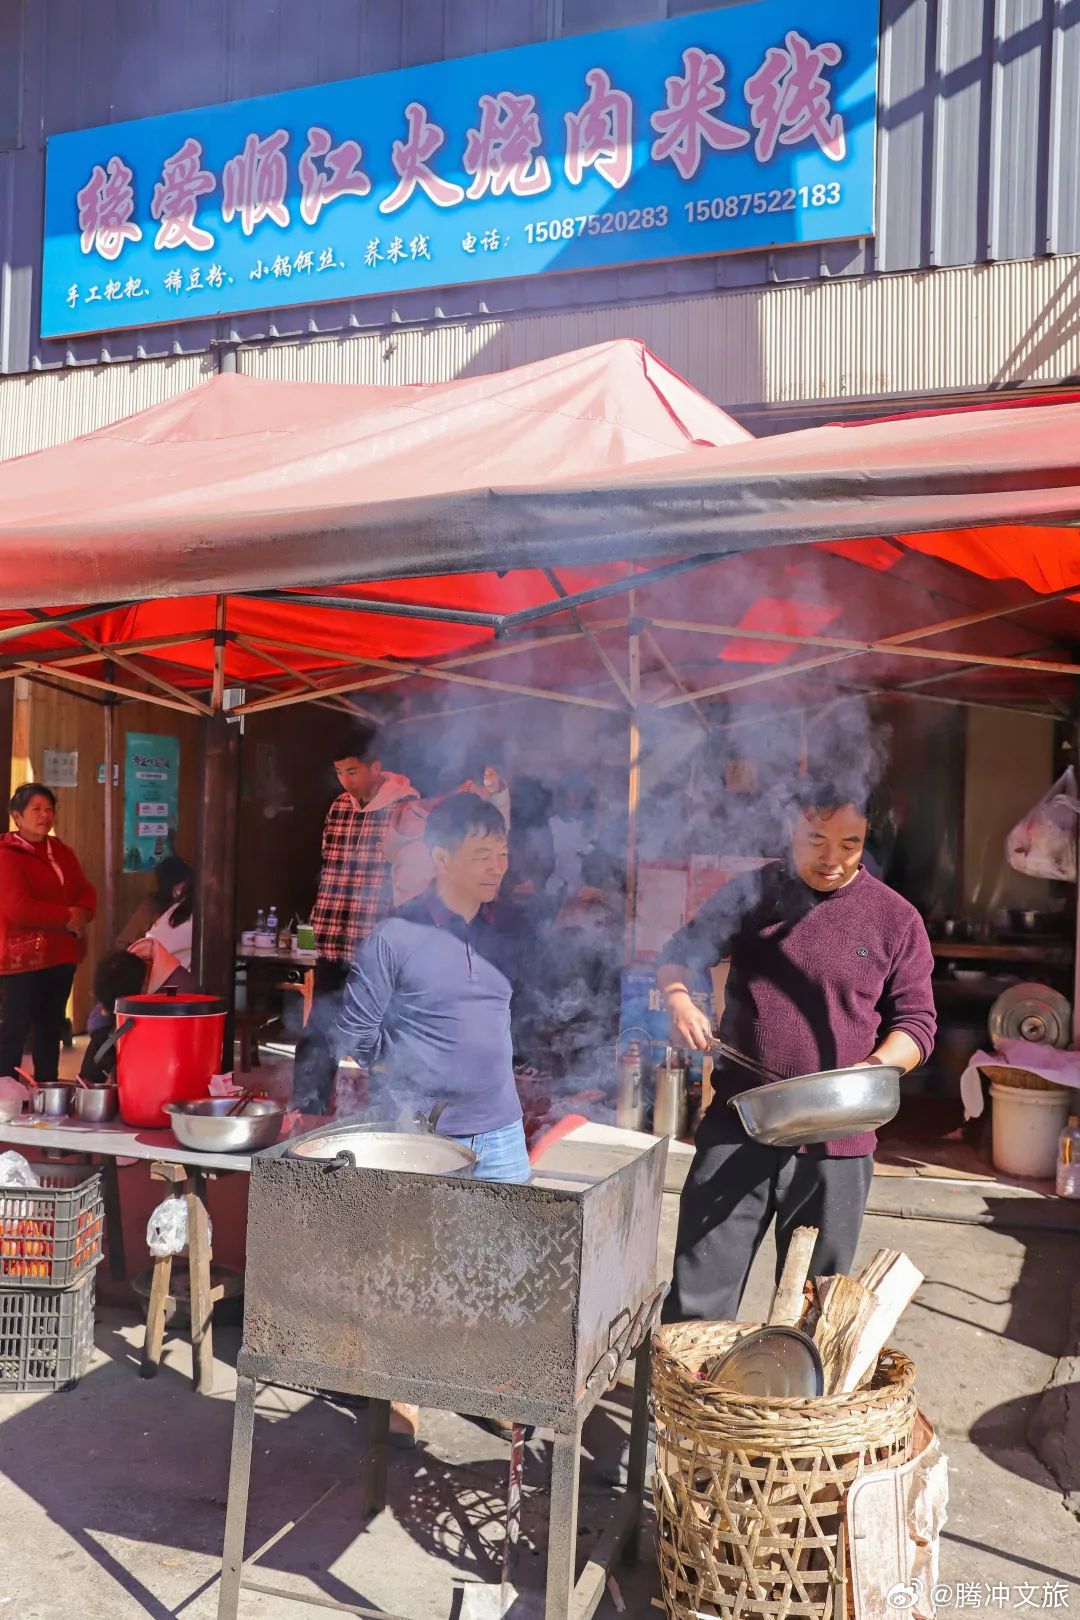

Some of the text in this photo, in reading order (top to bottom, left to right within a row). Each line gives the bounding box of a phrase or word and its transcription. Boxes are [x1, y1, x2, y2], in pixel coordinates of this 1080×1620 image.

[77, 30, 847, 261] 缘爱顺江火烧肉米线
[524, 205, 668, 244] 15087520283
[684, 182, 841, 223] 15087522183
